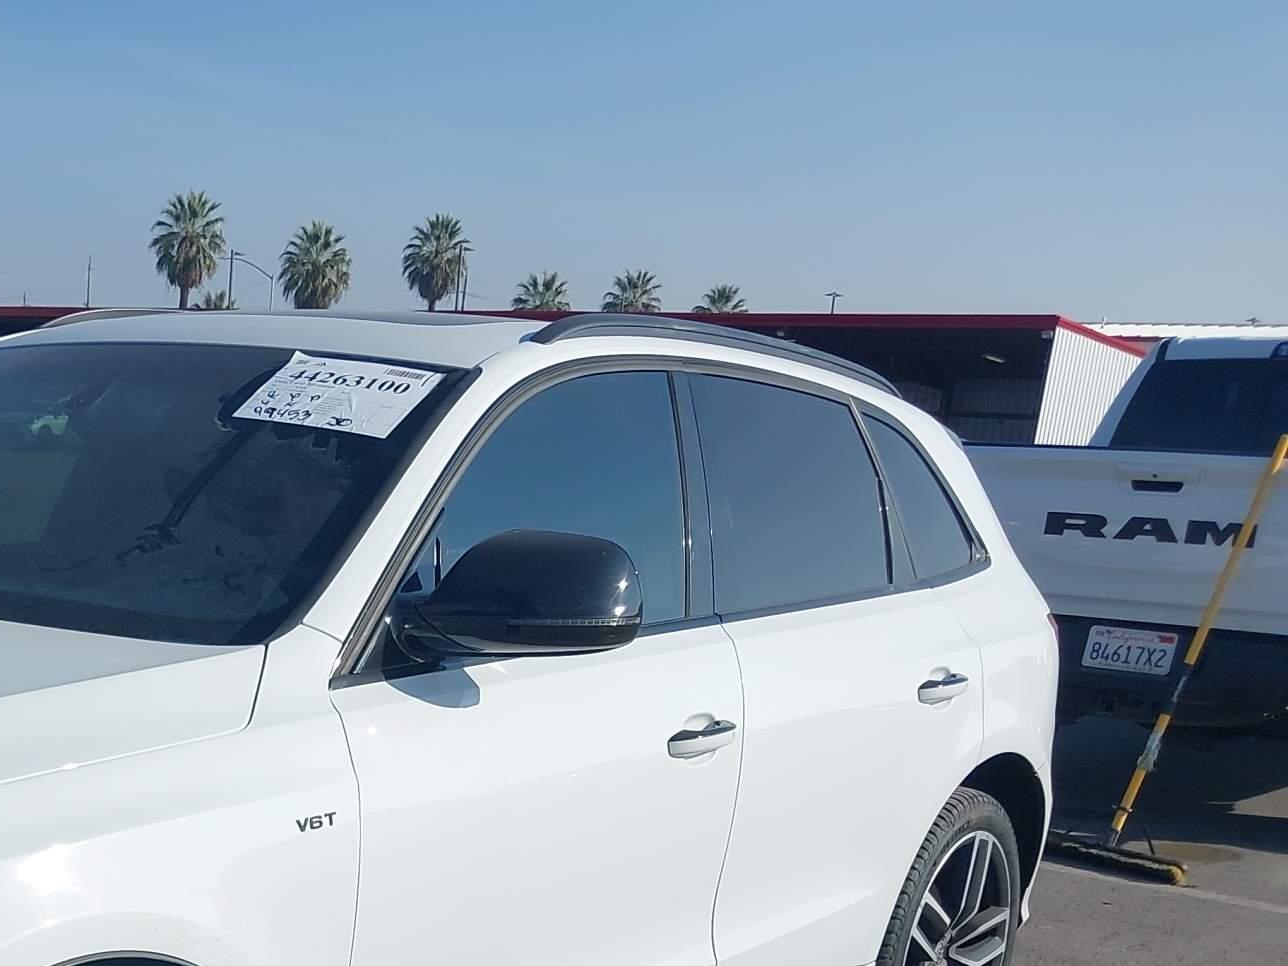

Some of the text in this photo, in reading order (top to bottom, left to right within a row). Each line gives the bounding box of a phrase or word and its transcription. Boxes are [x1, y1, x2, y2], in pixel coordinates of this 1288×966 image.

[289, 369, 412, 395] 44263100
[1044, 511, 1258, 549] RAM
[1089, 641, 1168, 669] 84617X2
[295, 811, 337, 833] V6T
